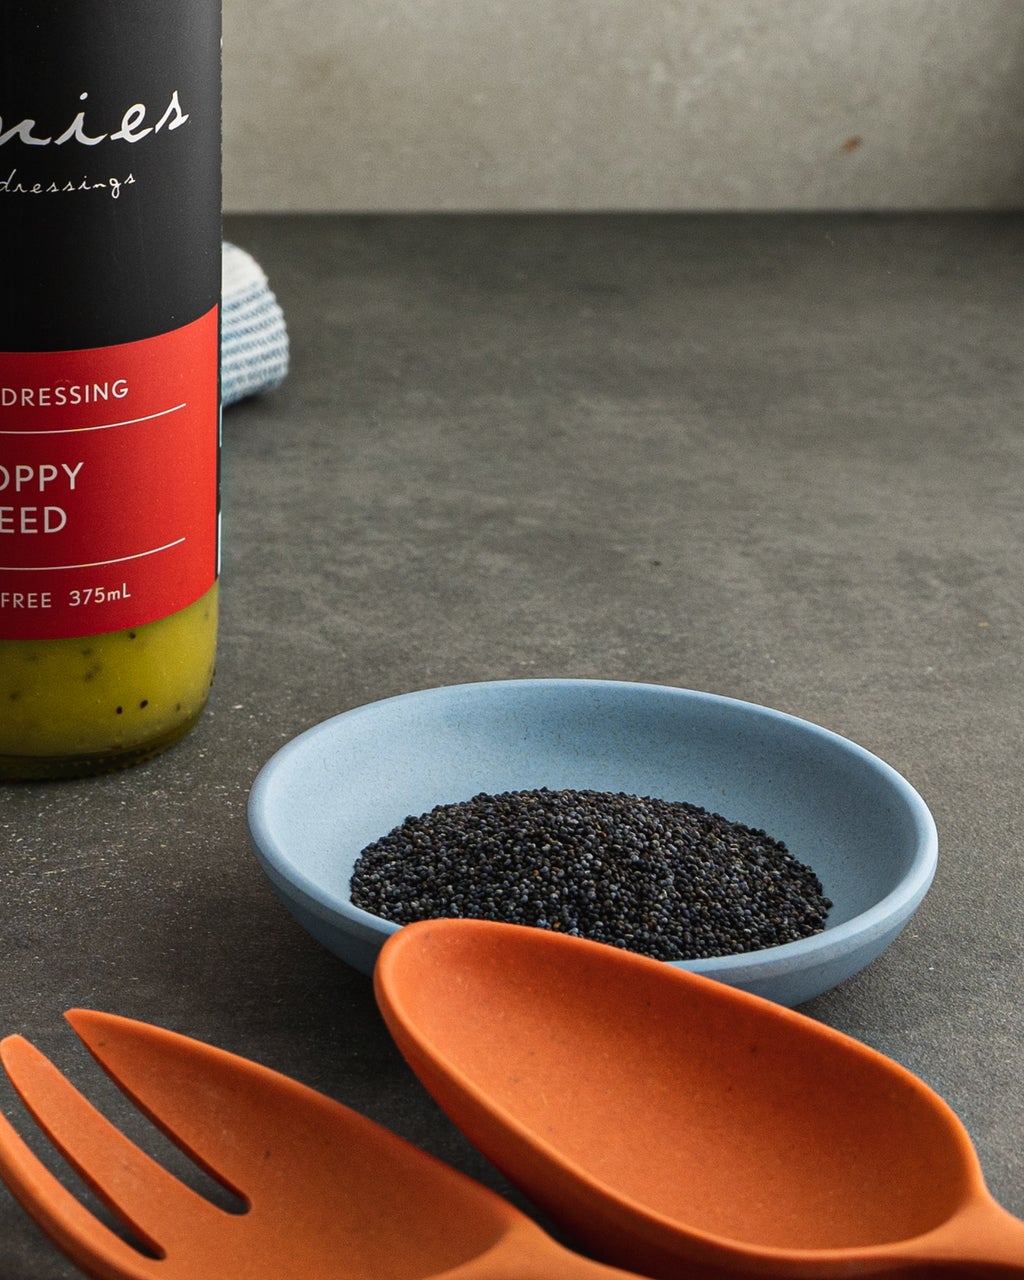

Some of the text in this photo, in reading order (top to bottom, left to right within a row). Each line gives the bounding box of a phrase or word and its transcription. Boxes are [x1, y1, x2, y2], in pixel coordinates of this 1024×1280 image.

[1, 378, 129, 407] DRESSING
[1, 592, 52, 609] FREE
[68, 582, 132, 607] 375mL
